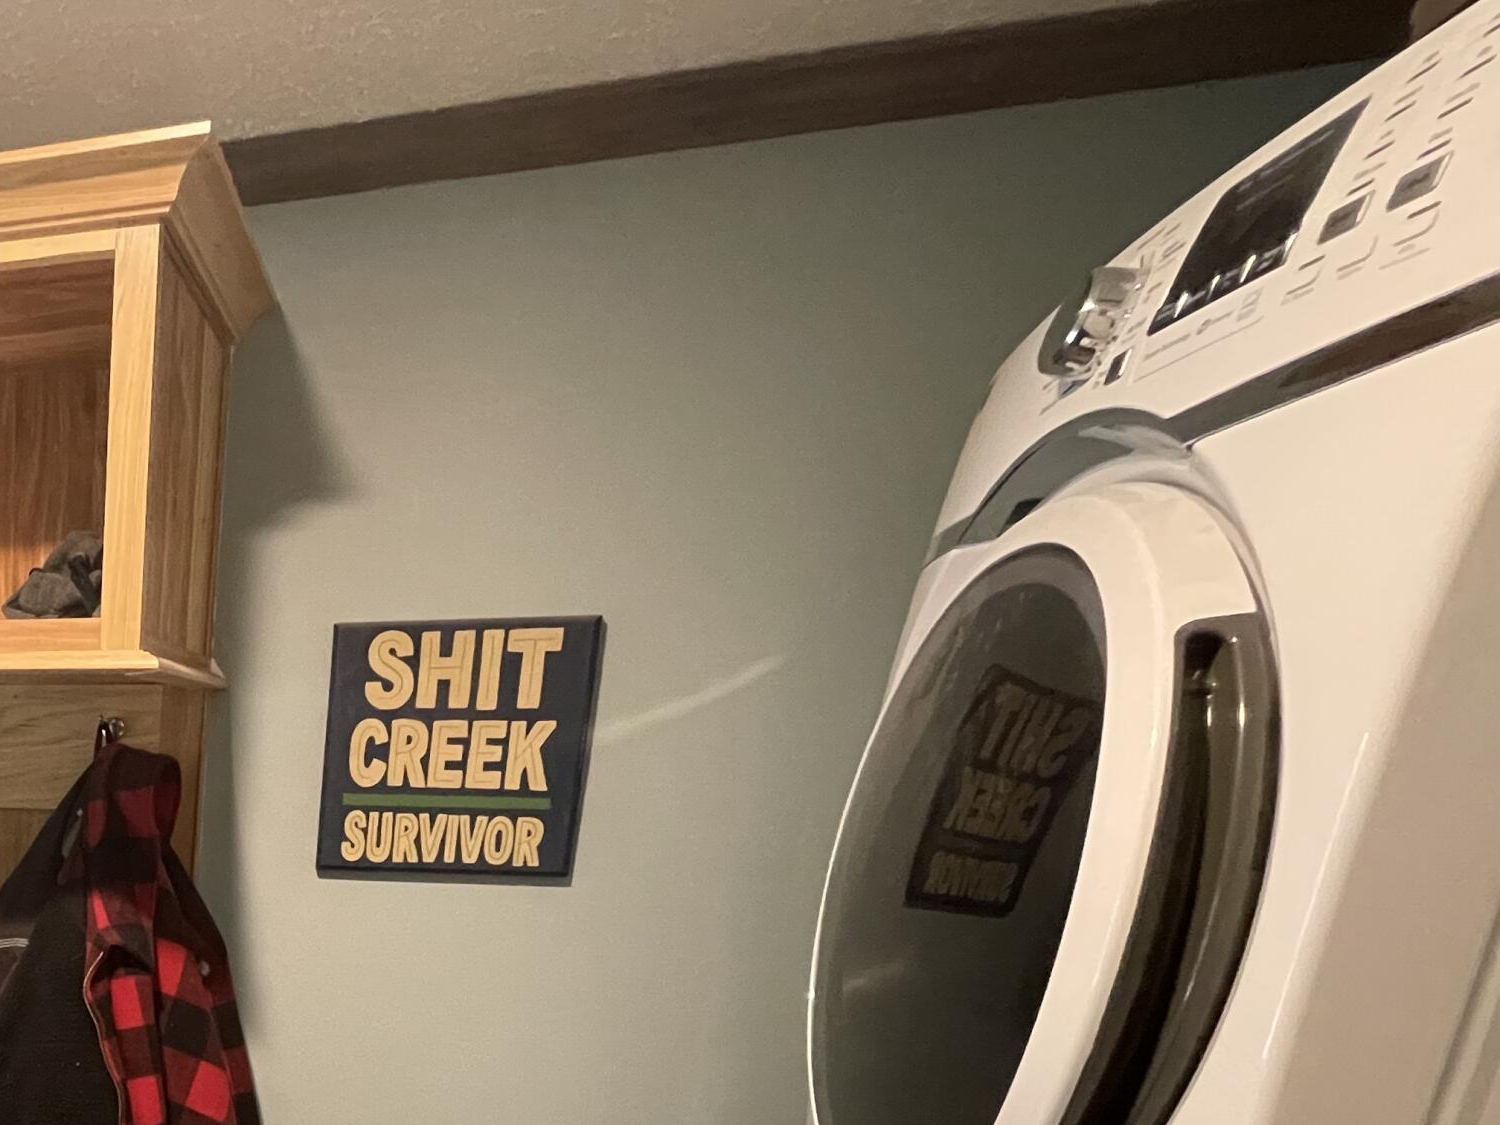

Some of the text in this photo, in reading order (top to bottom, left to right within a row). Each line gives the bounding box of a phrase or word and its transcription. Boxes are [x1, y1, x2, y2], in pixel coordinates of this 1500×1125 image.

[364, 626, 564, 710] SHIT
[349, 717, 557, 791] CREEK
[340, 809, 544, 867] SURVIVOR
